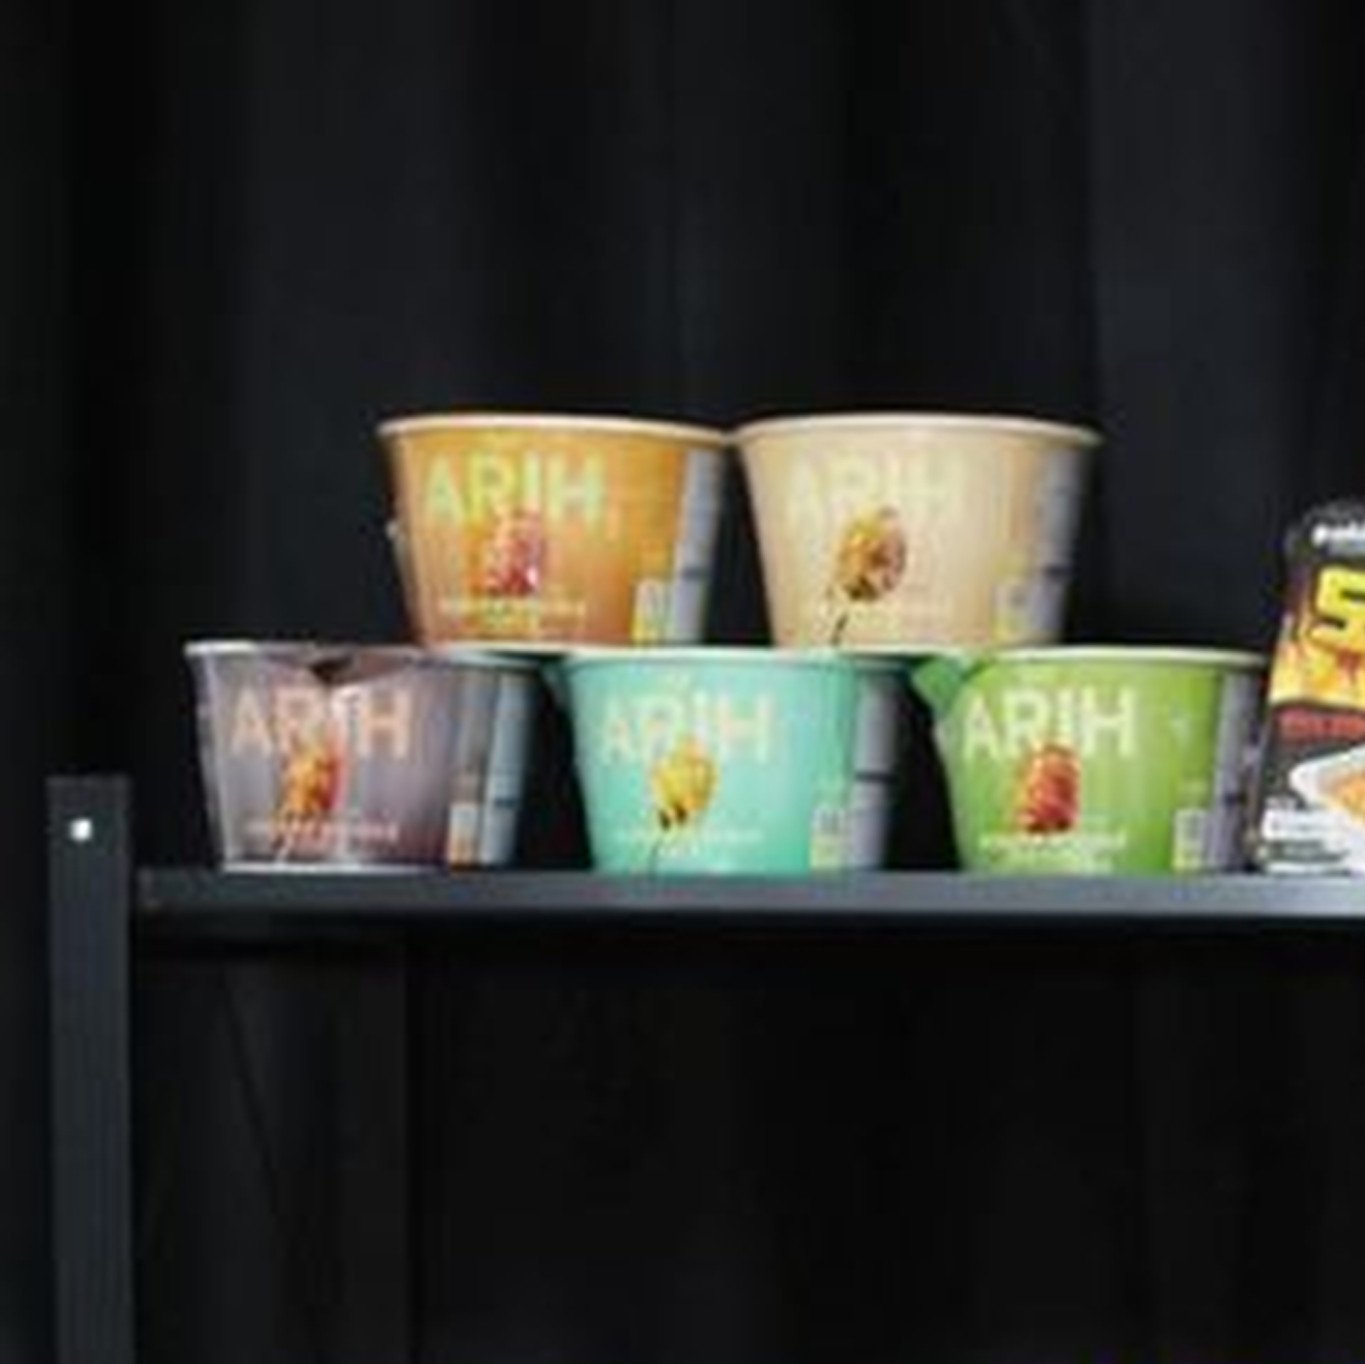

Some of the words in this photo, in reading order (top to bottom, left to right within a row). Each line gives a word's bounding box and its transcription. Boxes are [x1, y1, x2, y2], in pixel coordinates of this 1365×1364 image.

[427, 452, 610, 526] ARIH
[788, 454, 970, 526] ARIH
[231, 688, 412, 761] ARIH
[605, 688, 774, 764] ARIH
[961, 686, 1138, 761] ARIH
